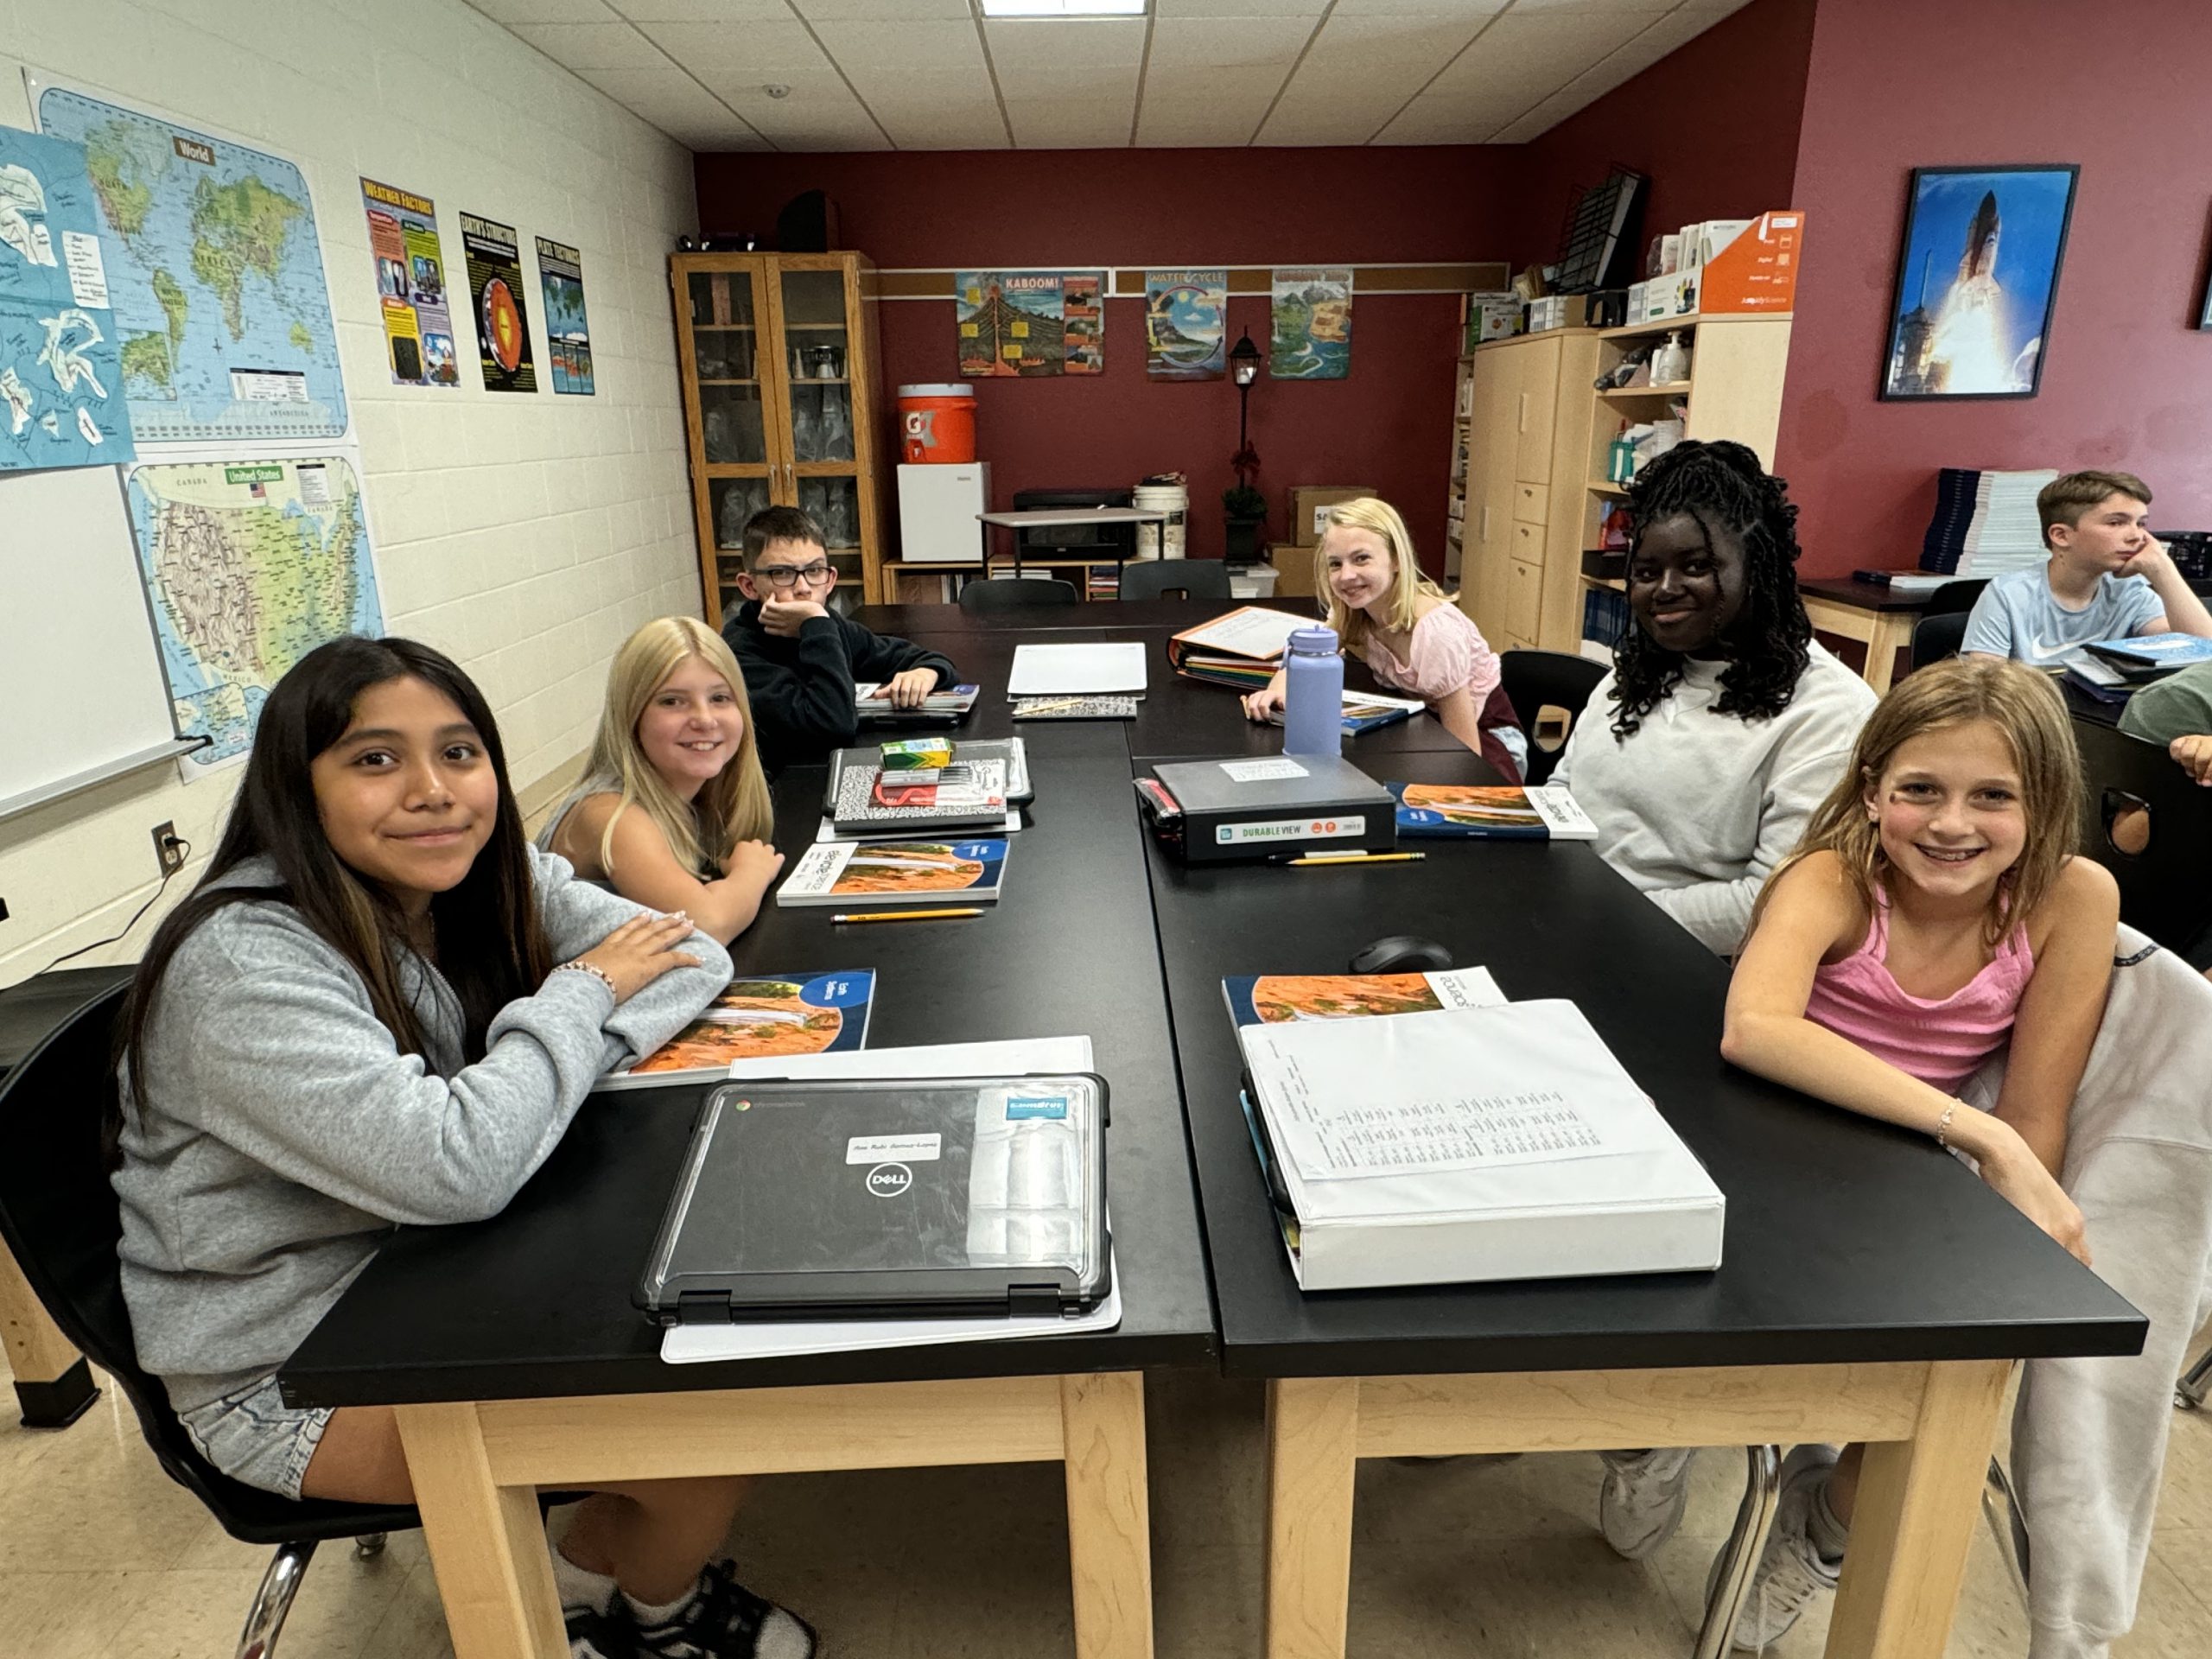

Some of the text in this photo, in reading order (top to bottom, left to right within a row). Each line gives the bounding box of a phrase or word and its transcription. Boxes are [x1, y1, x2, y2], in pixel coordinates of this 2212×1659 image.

[179, 138, 210, 163] World
[363, 180, 433, 215] WEATHER FACTORS
[461, 214, 517, 246] EARTH'S STRUCTURE
[537, 238, 554, 257] PLATE
[554, 243, 580, 264] TECTONICS
[1006, 277, 1058, 289] KABOOM!
[1150, 272, 1185, 283] WATER
[176, 478, 207, 486] CANADA
[228, 468, 281, 483] United States
[224, 674, 251, 683] MEXICO
[1243, 826, 1280, 837] DURABLE
[1281, 824, 1301, 835] VIEW
[872, 1173, 907, 1185] DELL
